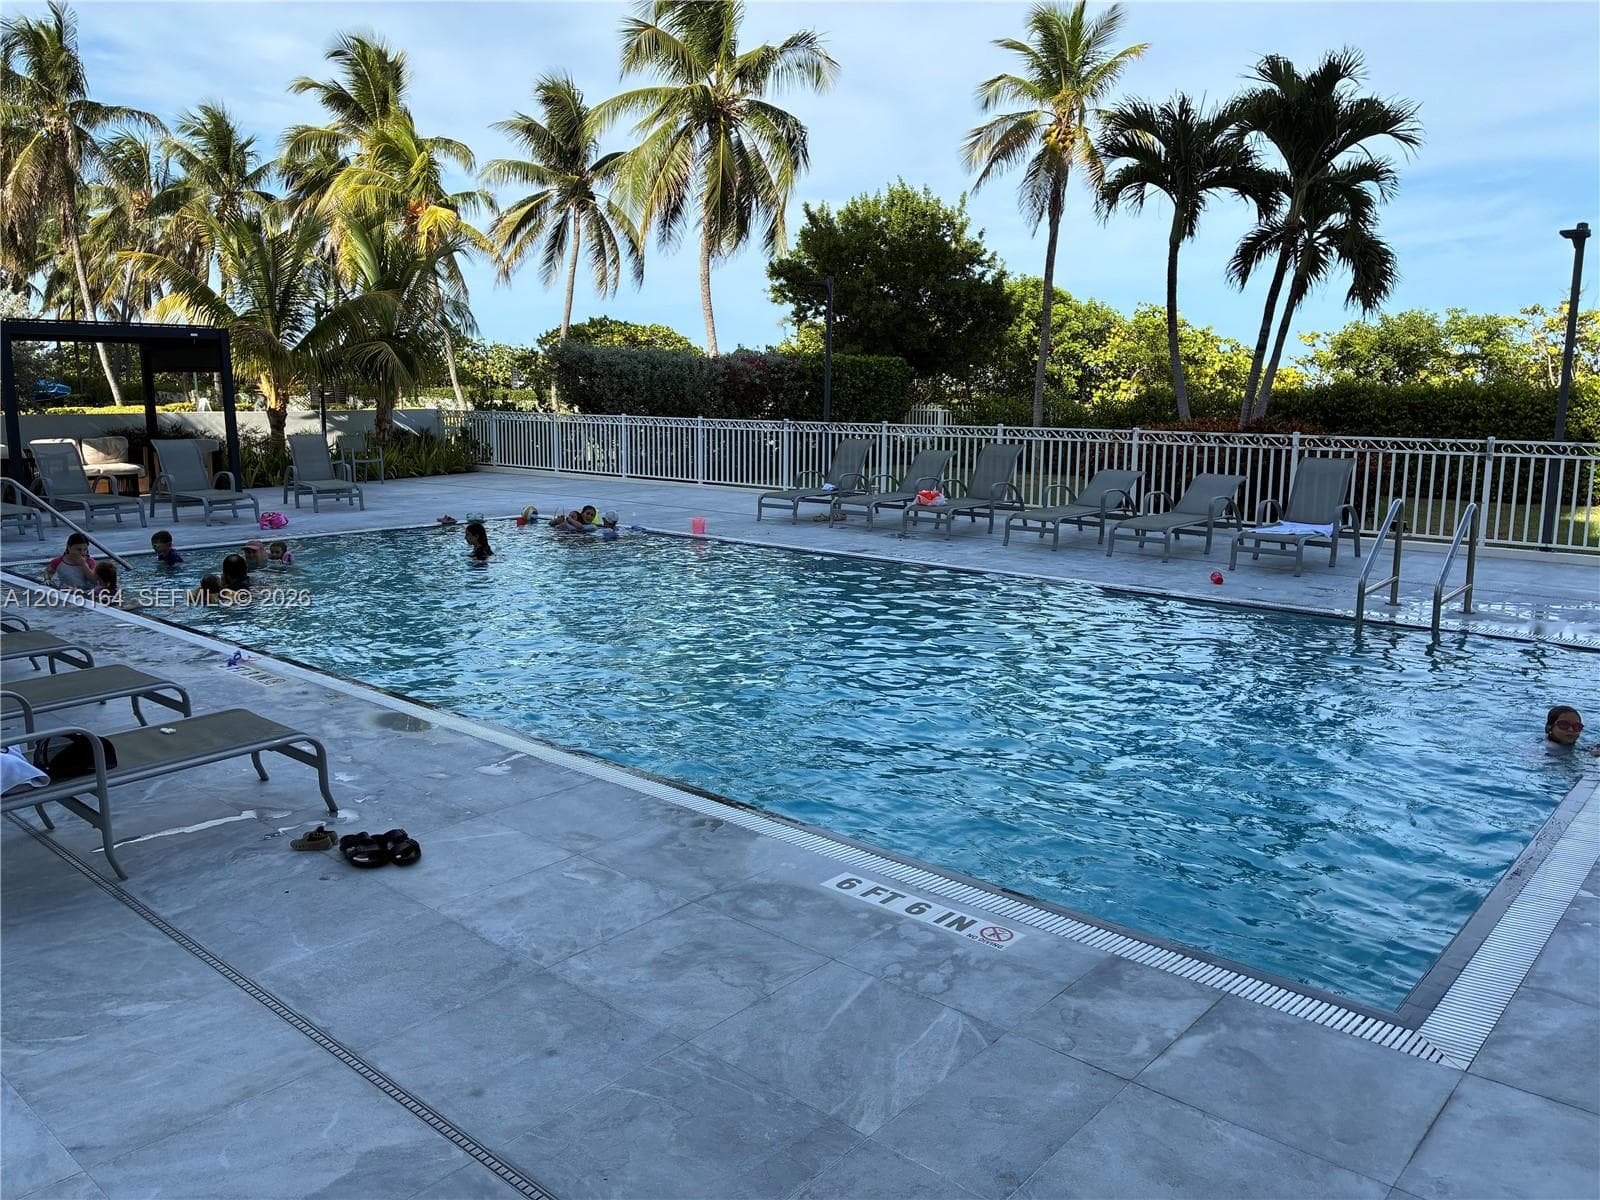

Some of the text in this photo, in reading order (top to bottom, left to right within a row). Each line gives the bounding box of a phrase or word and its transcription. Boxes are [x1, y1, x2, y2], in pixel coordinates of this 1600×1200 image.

[836, 878, 978, 932] 6 FT 6 IN
[977, 938, 1004, 950] DIVING
